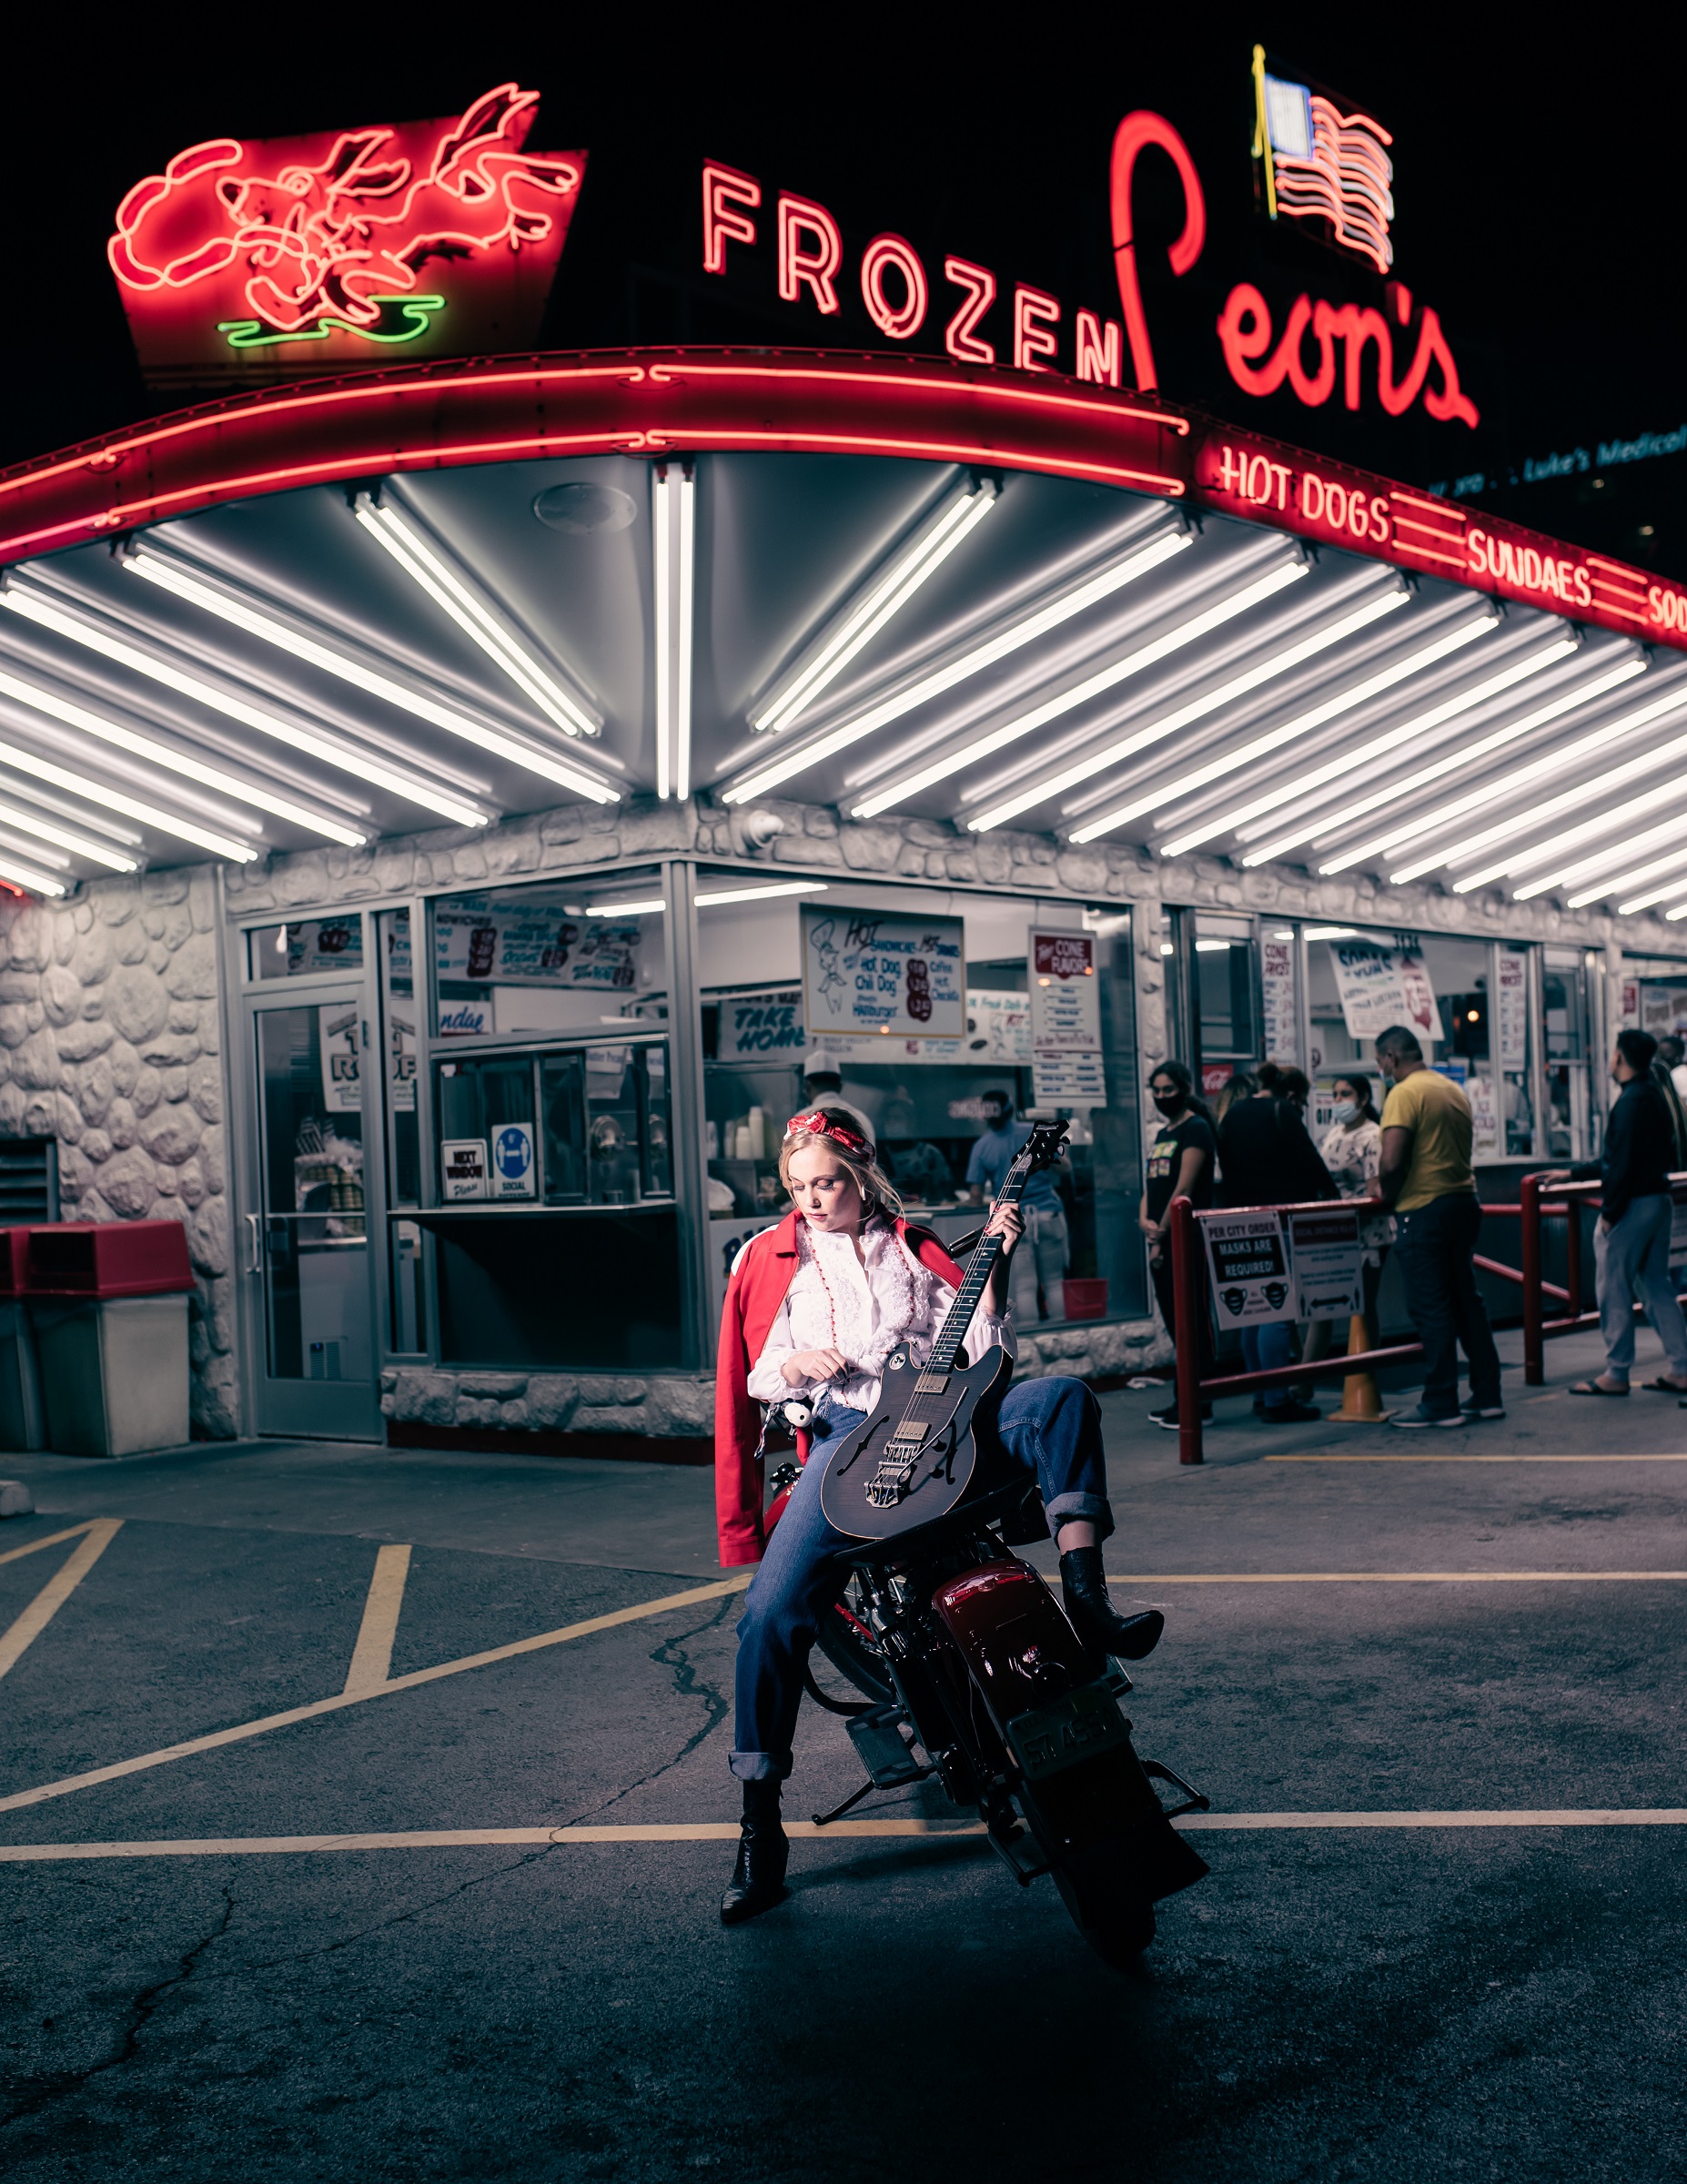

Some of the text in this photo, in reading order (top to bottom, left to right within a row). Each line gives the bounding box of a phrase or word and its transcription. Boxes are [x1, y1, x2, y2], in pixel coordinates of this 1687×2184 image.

[702, 158, 1121, 387] FROZEN
[1111, 110, 1480, 429] Leon's
[1220, 446, 1389, 543] HOT DOGS
[1468, 529, 1591, 607] SUNDAES
[1056, 940, 1085, 957] CONE
[734, 1006, 796, 1030] TAKE
[736, 1026, 806, 1052] HOME
[1208, 1222, 1277, 1239] PER CITY ORDER
[1219, 1239, 1272, 1256] MASKS ARE
[1225, 1260, 1274, 1277] REQUIRED!
[1023, 1733, 1056, 1766] 57
